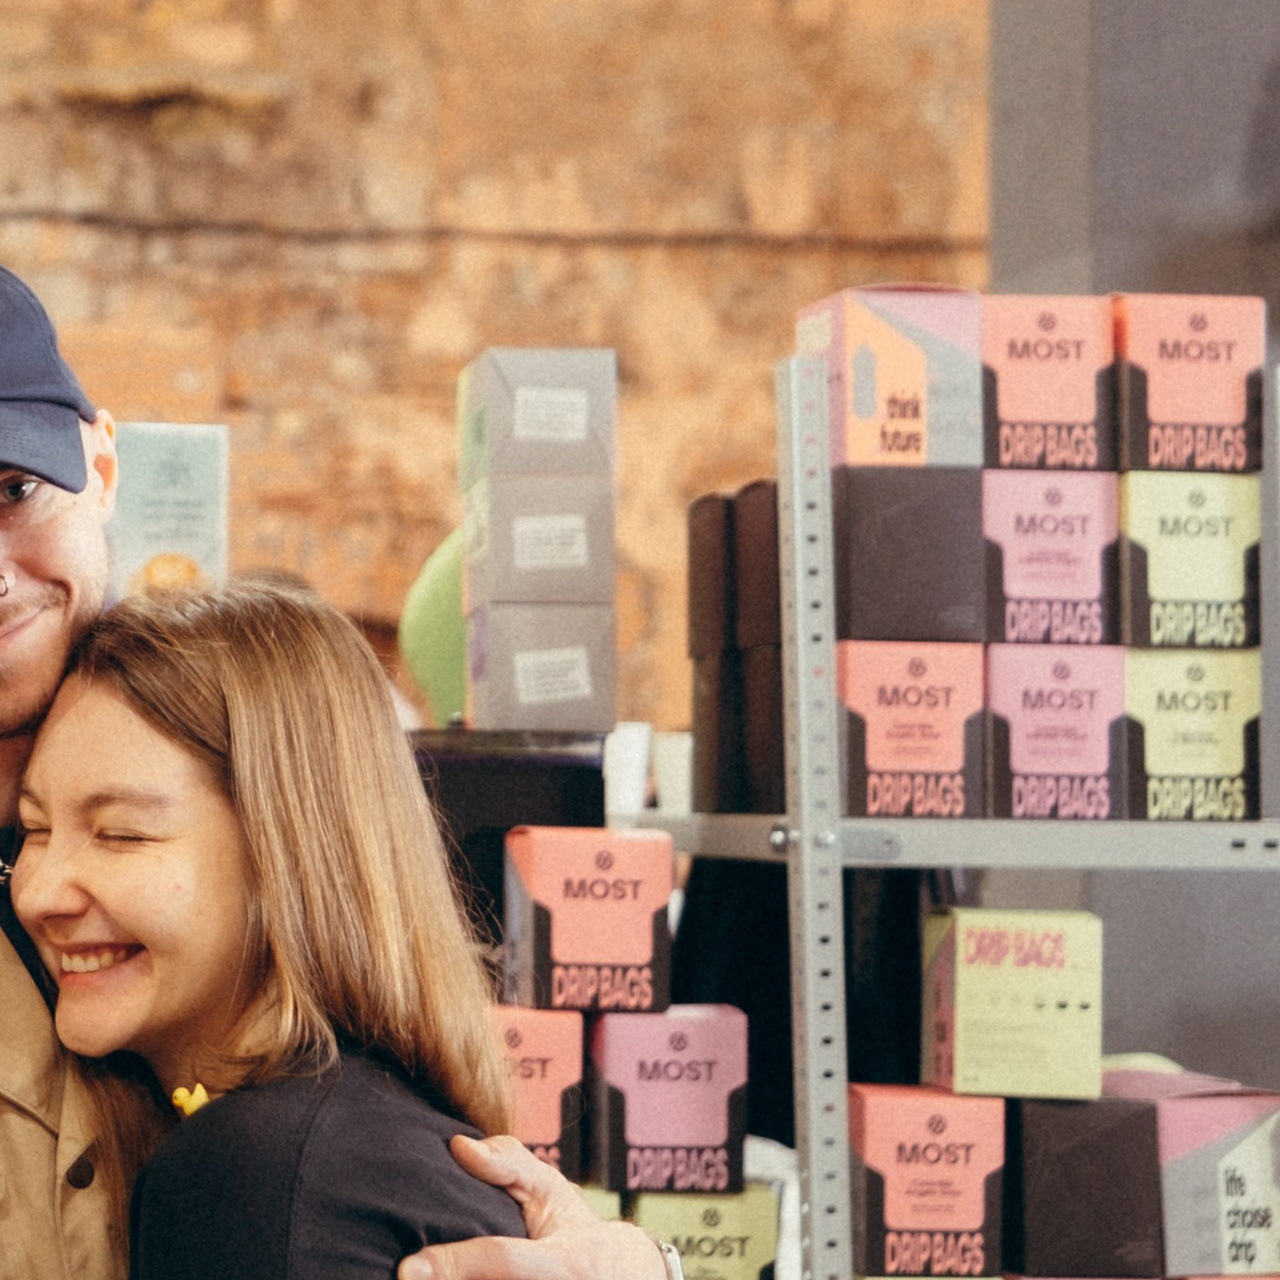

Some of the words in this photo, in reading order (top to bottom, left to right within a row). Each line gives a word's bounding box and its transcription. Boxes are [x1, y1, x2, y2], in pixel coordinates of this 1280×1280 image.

[1008, 339, 1083, 360] MOST
[1159, 340, 1234, 361] MOST
[1015, 515, 1089, 535] MOST
[1159, 516, 1237, 536] MOST
[877, 686, 953, 708] MOST
[1022, 689, 1096, 710] MOST
[1157, 690, 1234, 712] MOST
[563, 879, 643, 900] MOST
[516, 1057, 552, 1079] ST
[638, 1059, 720, 1083] MOST
[896, 1143, 975, 1165] MOST
[672, 1236, 750, 1258] MOST
